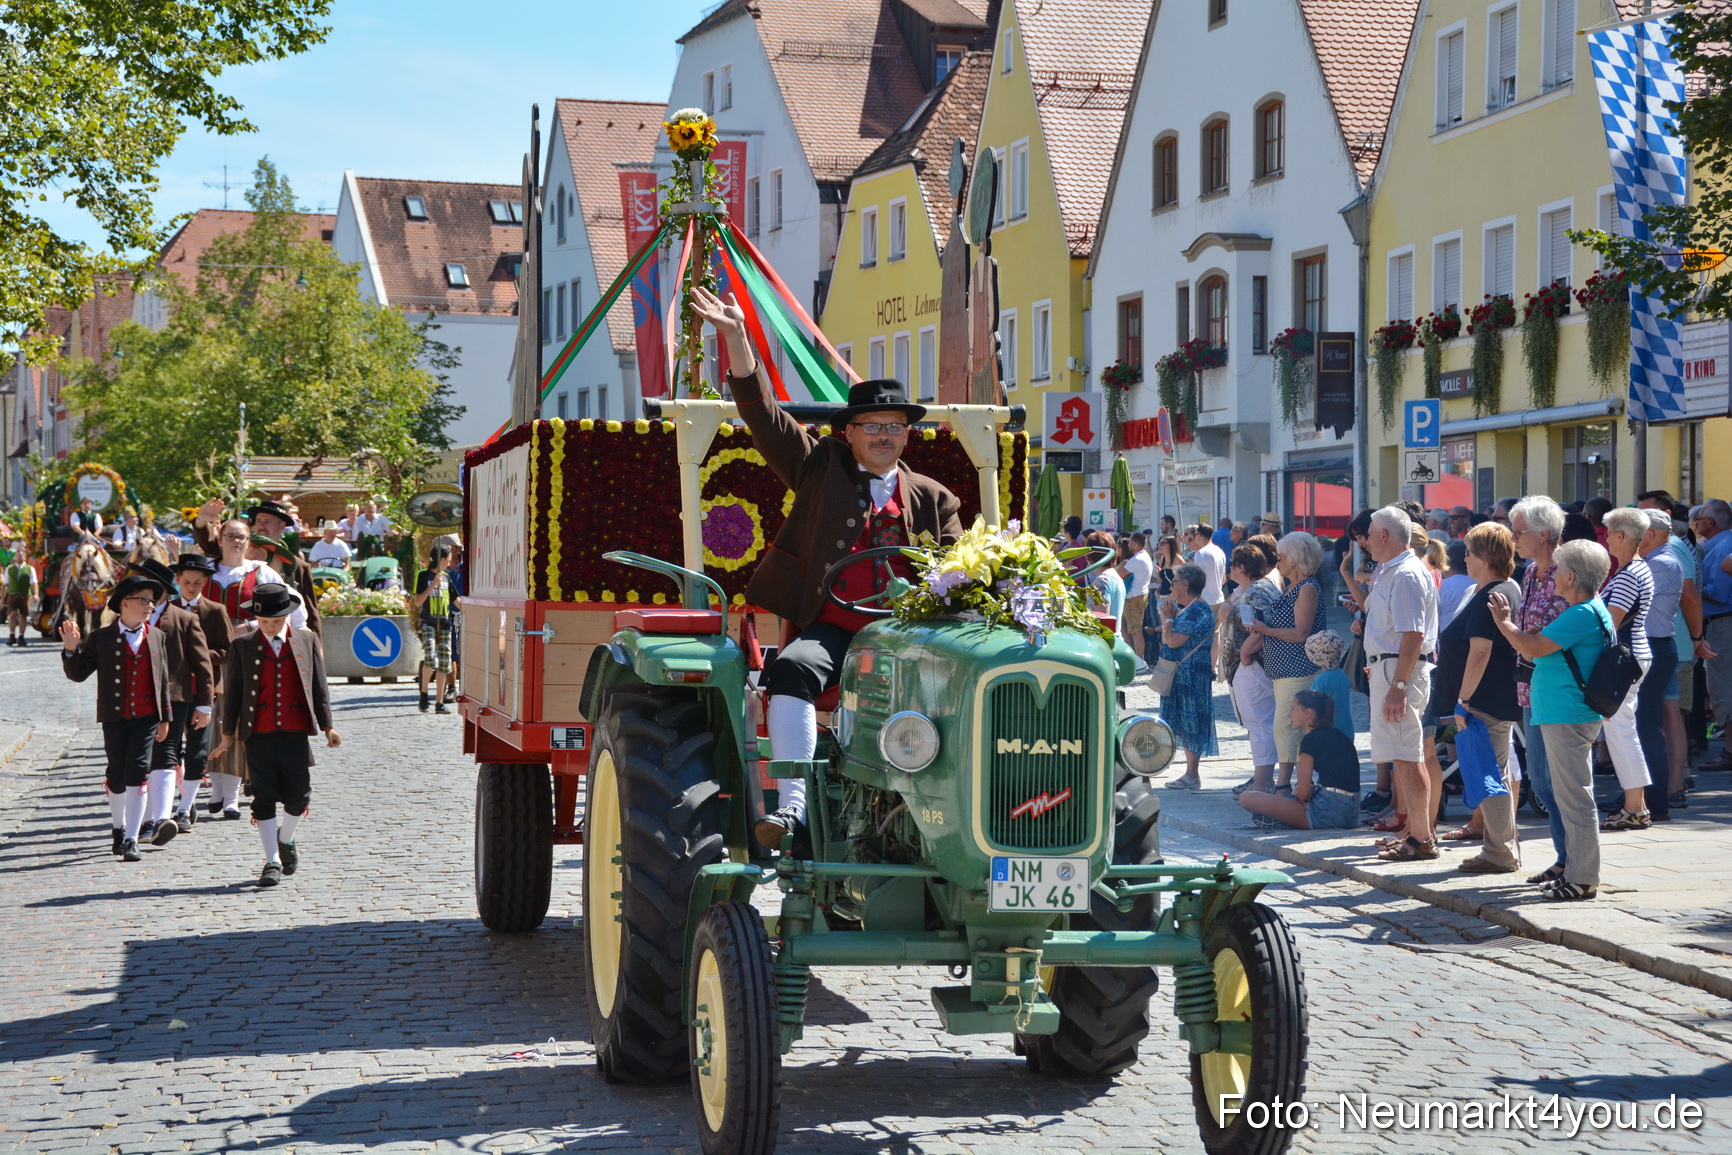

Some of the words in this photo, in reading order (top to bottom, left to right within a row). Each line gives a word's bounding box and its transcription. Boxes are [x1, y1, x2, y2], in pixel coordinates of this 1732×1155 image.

[732, 150, 741, 203] RUPPERT
[877, 296, 907, 327] HOTEL
[1694, 359, 1716, 379] KINO
[1440, 377, 1461, 393] WOLLE
[1412, 406, 1432, 442] P
[1187, 464, 1208, 476] APOTHEKE
[486, 460, 497, 517] 60
[498, 455, 519, 517] Jahre
[922, 809, 931, 823] 18
[932, 810, 944, 825] PS
[997, 872, 1004, 880] D
[1011, 860, 1042, 883] NM
[1005, 885, 1036, 908] JK
[1046, 885, 1075, 908] 46
